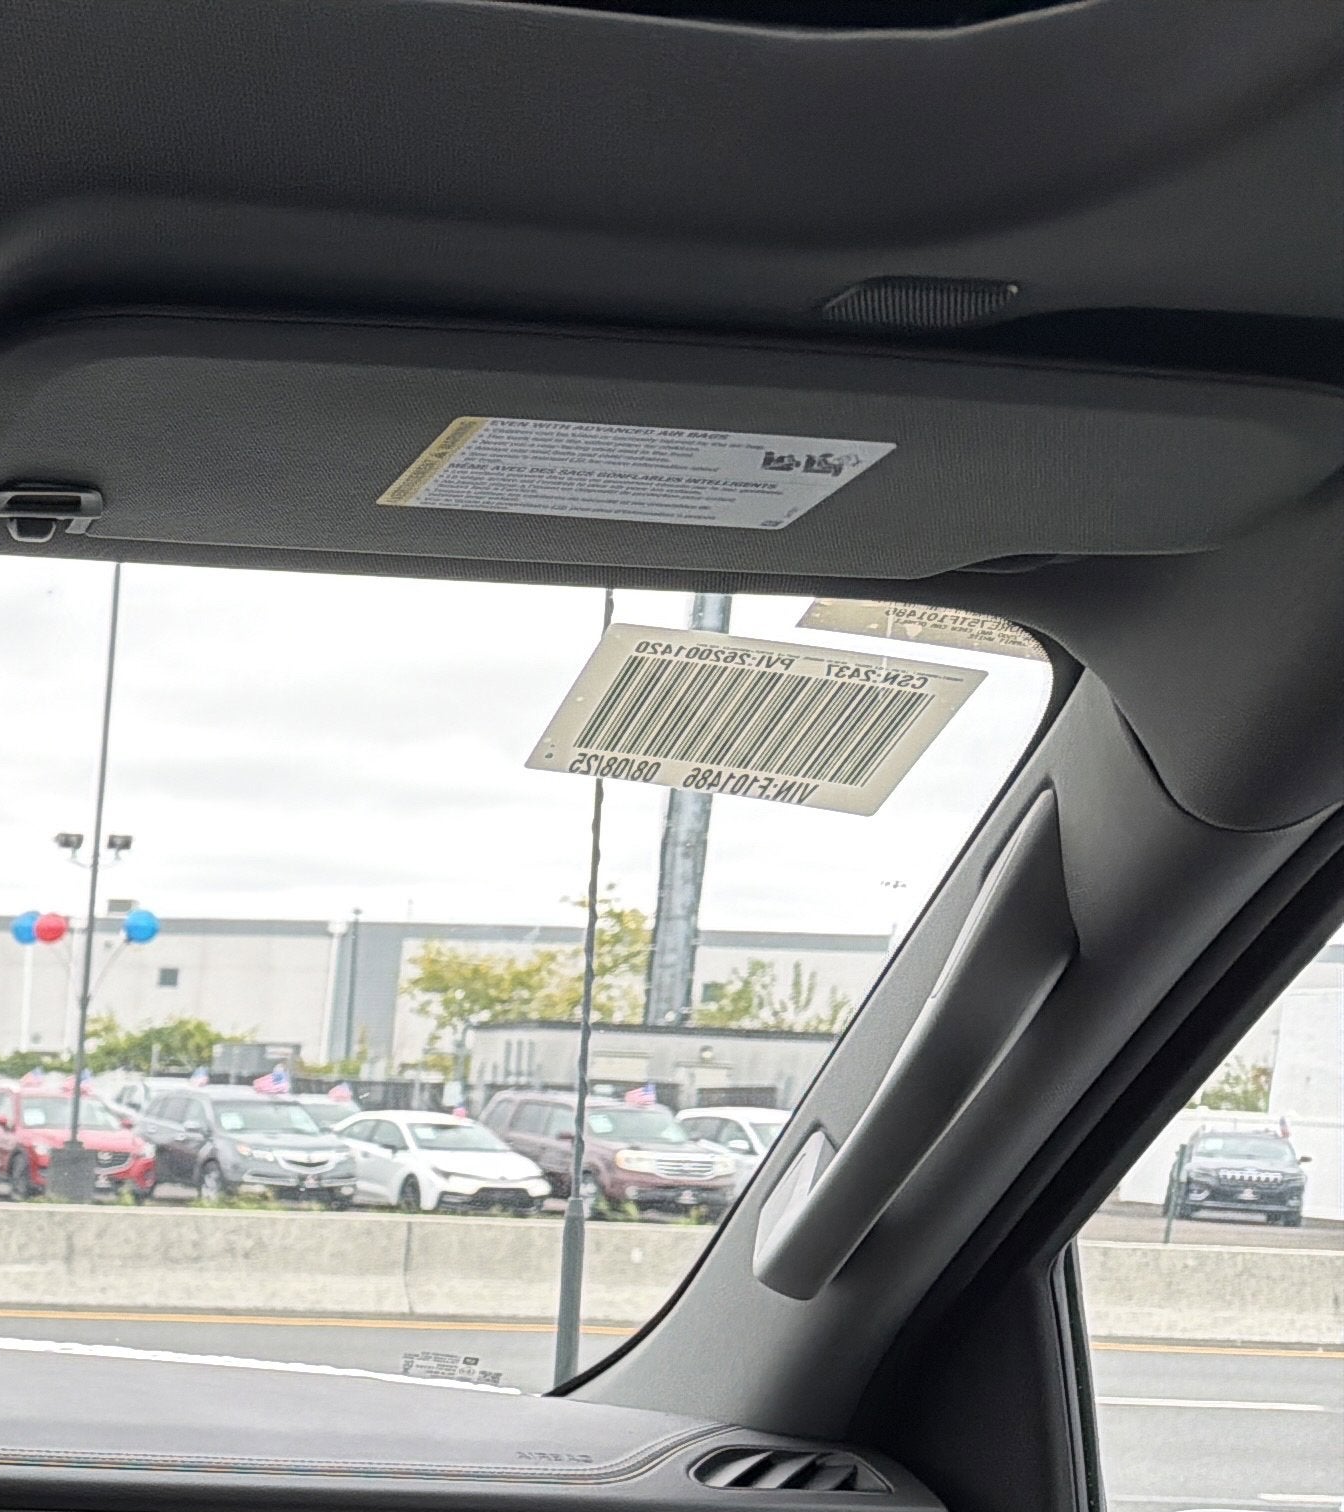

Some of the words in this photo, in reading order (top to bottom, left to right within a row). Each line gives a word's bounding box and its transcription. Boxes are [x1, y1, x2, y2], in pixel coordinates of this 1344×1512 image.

[489, 419, 529, 428] EVEN
[532, 422, 571, 430] WITH
[572, 424, 655, 435] ADVANCED
